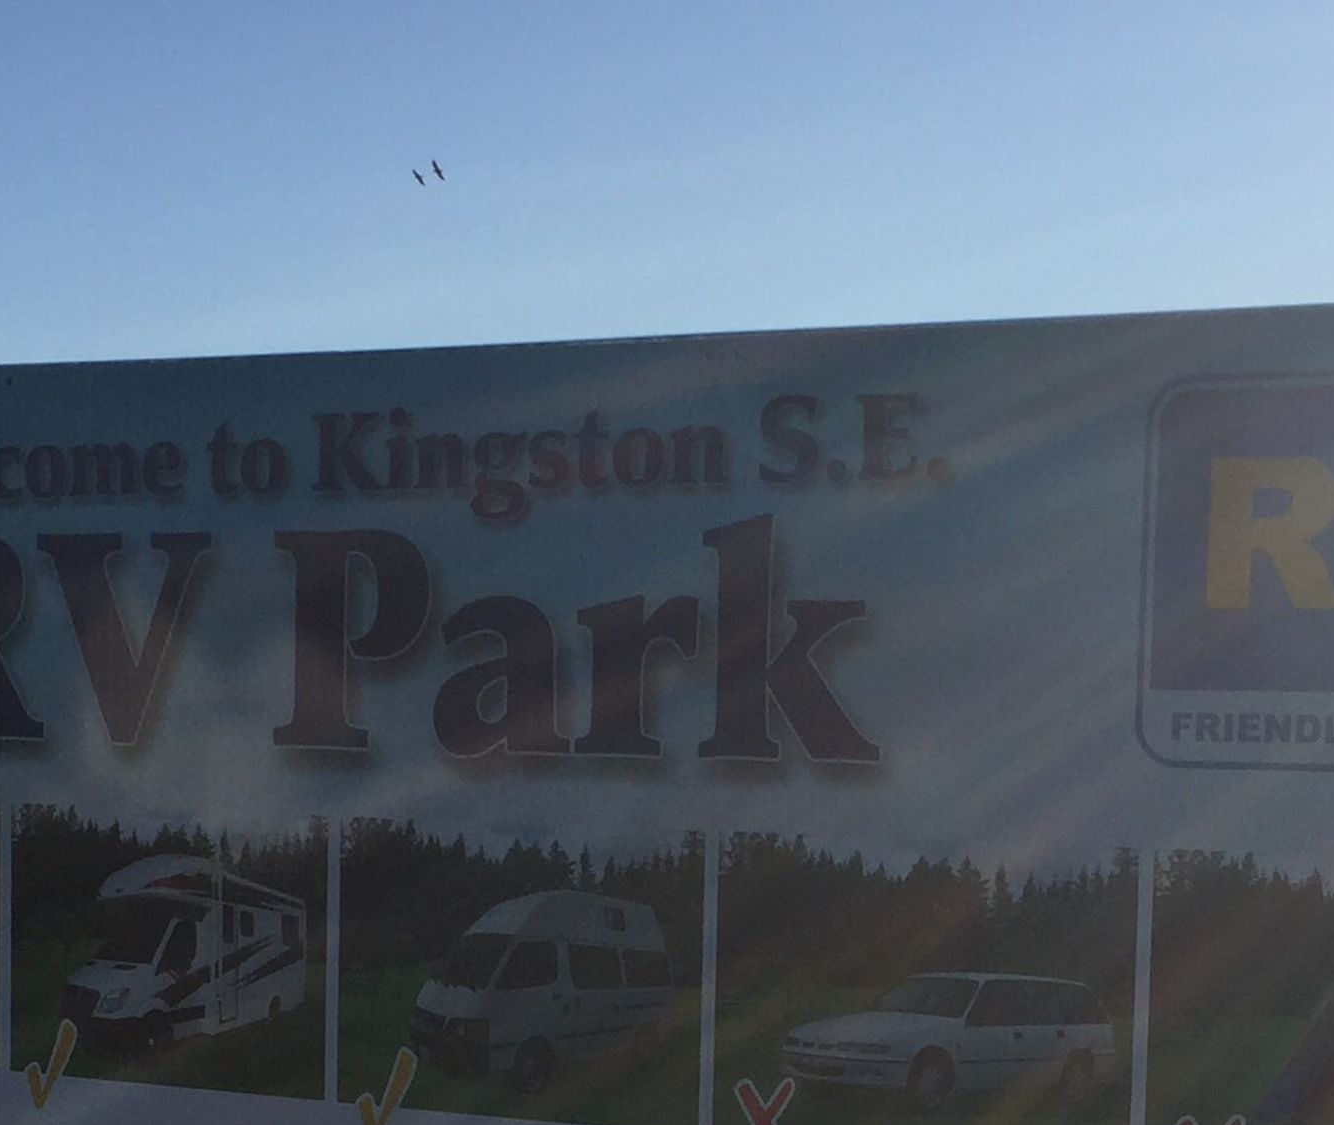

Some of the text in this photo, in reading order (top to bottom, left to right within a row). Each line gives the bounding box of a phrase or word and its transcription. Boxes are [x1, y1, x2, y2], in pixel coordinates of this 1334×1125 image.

[206, 421, 289, 495] to
[311, 407, 730, 522] Kingston
[758, 392, 952, 484] S.E.
[272, 512, 883, 763] Park
